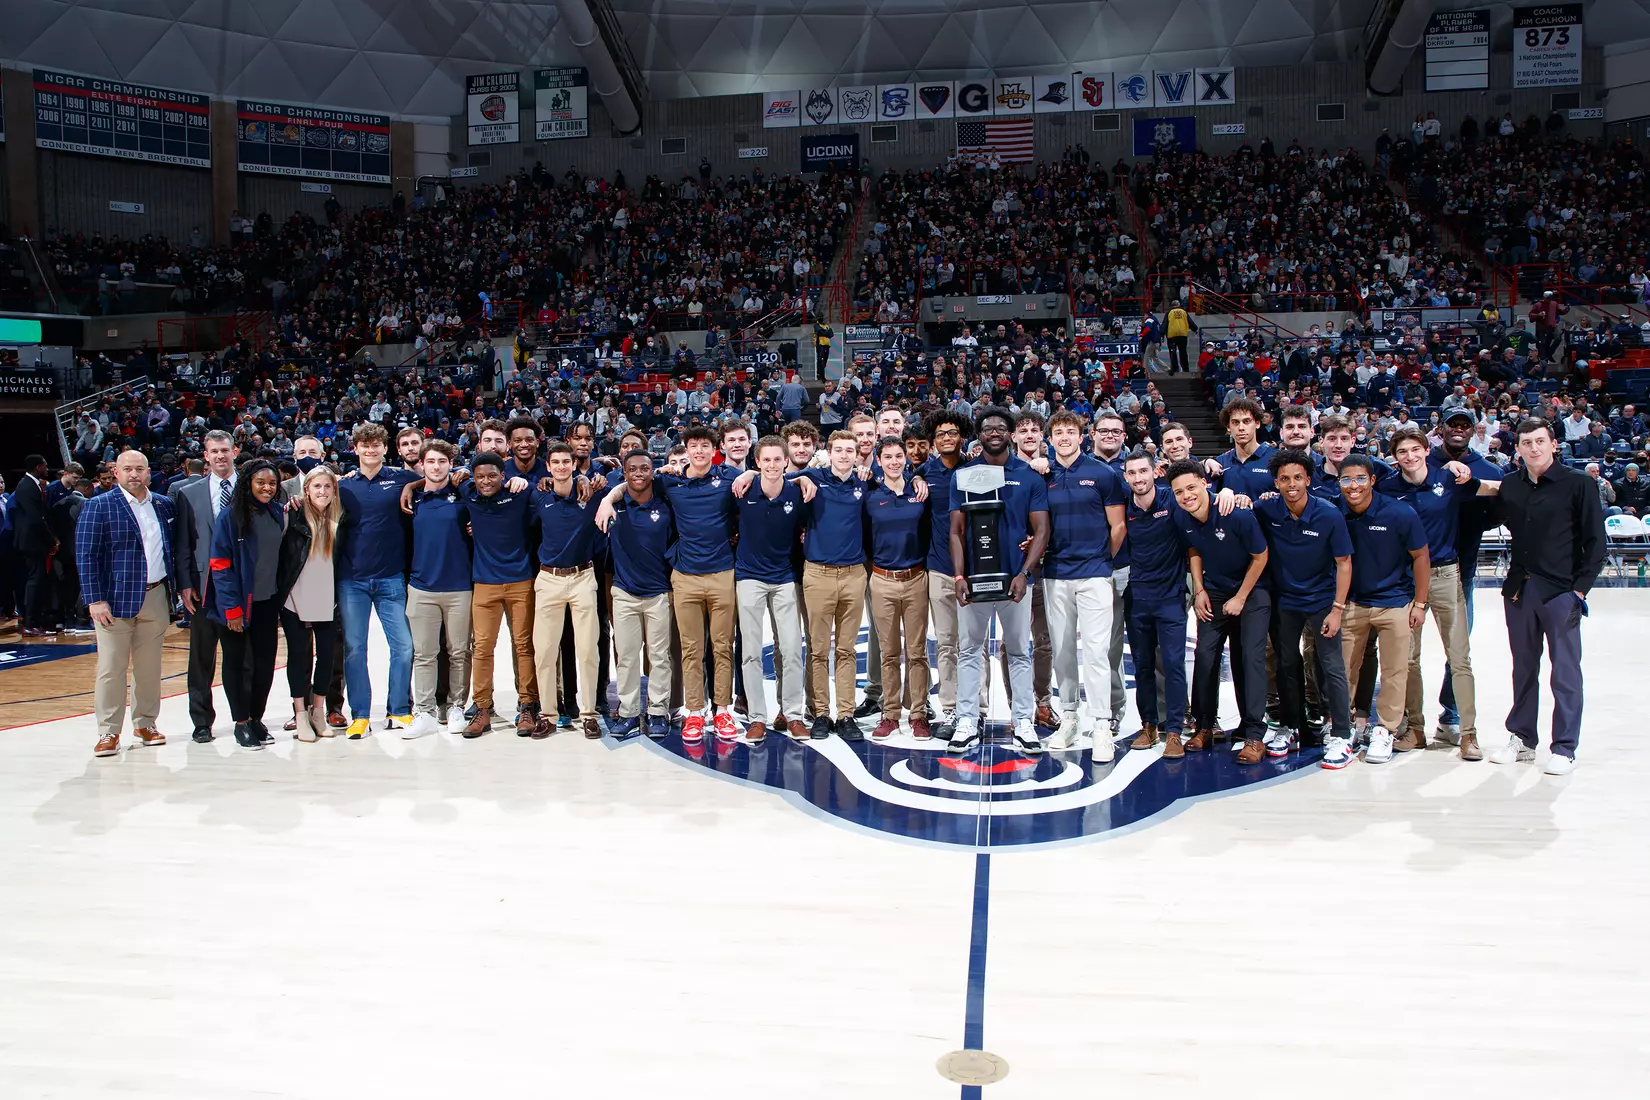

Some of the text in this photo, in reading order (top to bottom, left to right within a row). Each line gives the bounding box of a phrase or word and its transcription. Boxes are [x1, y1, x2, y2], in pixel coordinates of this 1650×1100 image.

[1436, 12, 1477, 20] NATIONAL
[1535, 16, 1577, 24] CALHOUN
[1525, 27, 1570, 47] 873
[472, 73, 516, 87] JIM CALHOUN
[44, 74, 199, 104] NCAA CHAMPIONSHIP
[1157, 73, 1191, 104] V
[1198, 71, 1232, 102] X
[38, 93, 57, 105] 1964
[65, 97, 84, 109] 1990
[91, 91, 158, 107] ELITE EIGHT
[958, 84, 989, 112] G
[91, 100, 109, 112] 1995
[117, 104, 134, 116] 1998
[38, 110, 59, 122] 2006
[142, 108, 159, 120] 1999
[165, 112, 183, 124] 2002
[247, 104, 381, 124] NCAA CHAMPIONSHIP
[1584, 109, 1603, 117] 223
[65, 114, 85, 125] 2009
[92, 117, 110, 129] 2011
[189, 115, 207, 126] 2004
[288, 117, 314, 126] FINAL
[116, 120, 135, 132] 2014
[541, 121, 582, 132] JIM CALHOUN
[41, 140, 206, 166] CONNECTICUT MEN'S BASKETBALL
[750, 148, 767, 156] 220
[807, 145, 853, 157] UCONN
[242, 164, 302, 175] CONNECTICUT
[334, 172, 386, 181] BASKETBALL
[1116, 345, 1136, 354] 121
[756, 352, 778, 363] 120
[557, 360, 577, 369] 10
[216, 376, 231, 384] 118
[1153, 510, 1168, 518] UCONN
